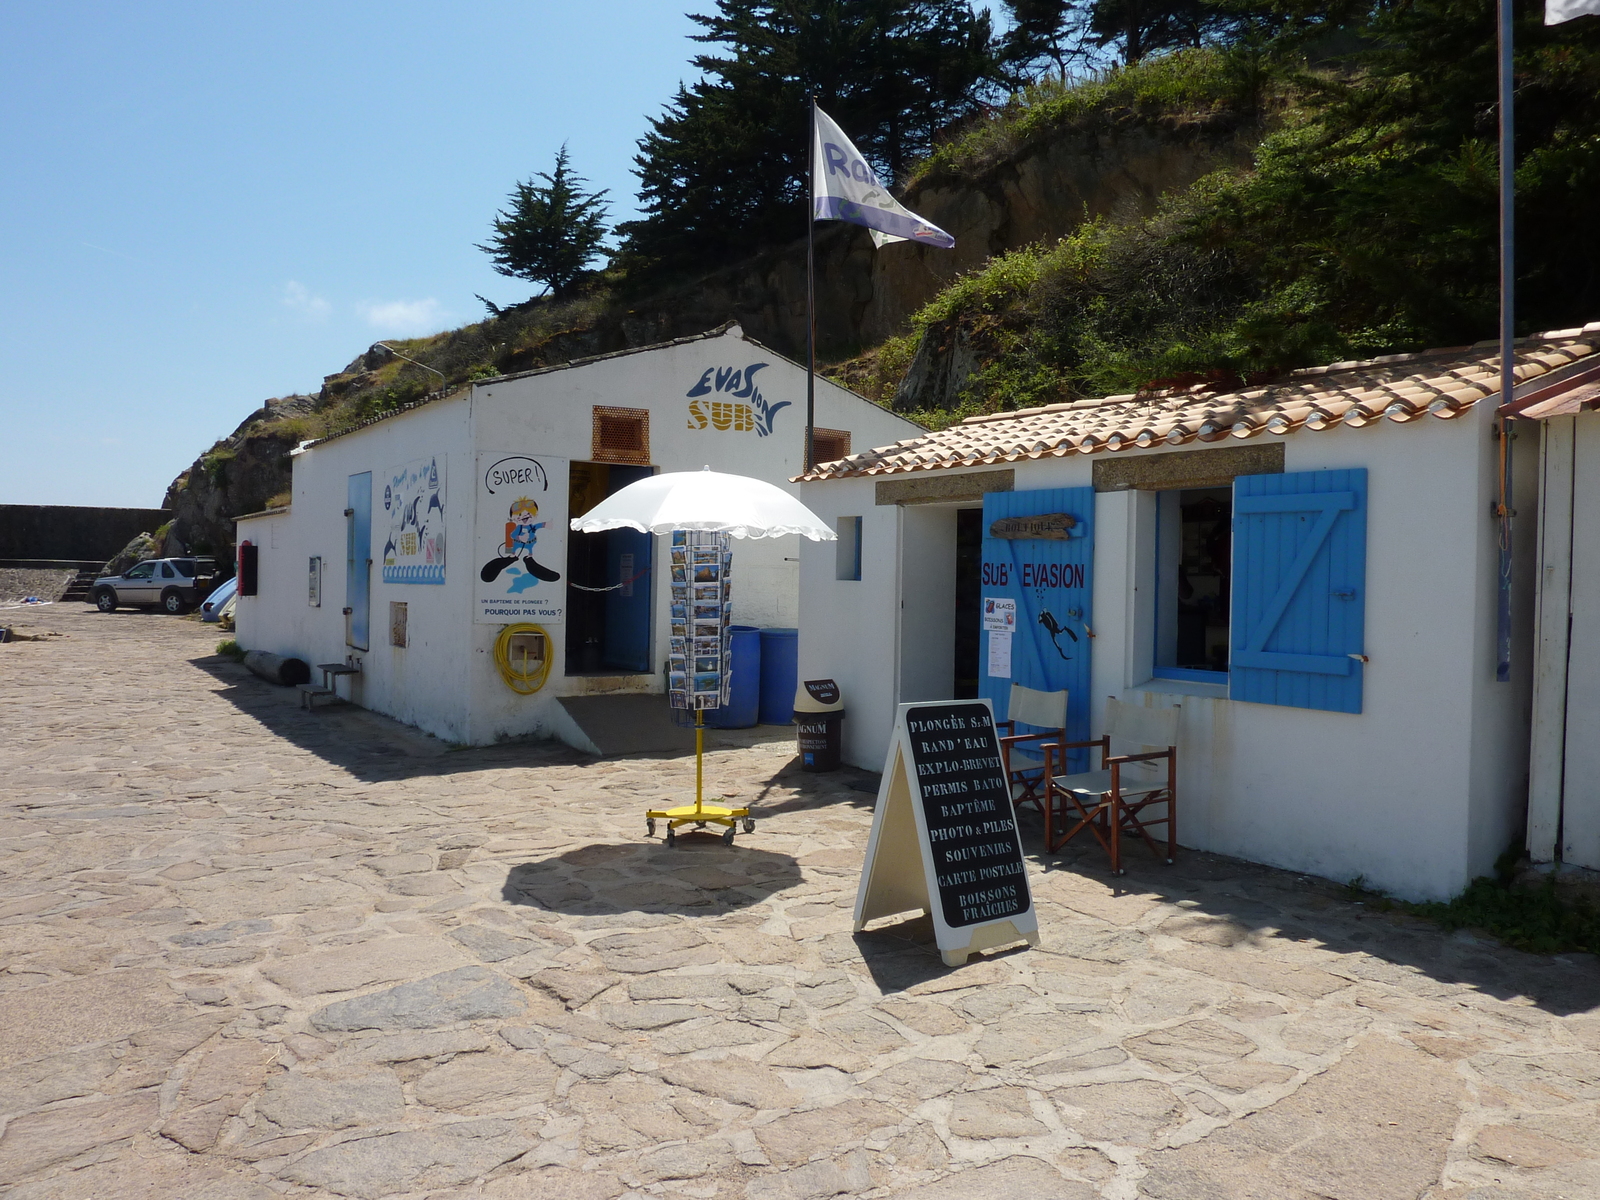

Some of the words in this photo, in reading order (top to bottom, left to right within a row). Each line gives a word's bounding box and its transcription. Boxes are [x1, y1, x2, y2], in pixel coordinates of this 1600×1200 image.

[686, 362, 792, 434] EVASION
[687, 400, 755, 431] SUB
[1022, 563, 1085, 588] EVASION
[484, 608, 521, 616] POURQUOI
[996, 602, 1015, 610] GLACES
[808, 683, 835, 692] MAGNUM
[923, 781, 968, 798] PERMIS
[974, 777, 1003, 791] BATO
[941, 799, 996, 817] BAPTÊME
[930, 824, 973, 842] PHOTO
[975, 826, 982, 835] &
[983, 818, 1014, 834] PILES
[946, 841, 1012, 863] SOUVENIRS
[938, 870, 977, 888] CARTE
[980, 861, 1023, 880] POSTALE
[959, 885, 1017, 908] BOISSONS
[963, 899, 1018, 921] FRAÎCHES
